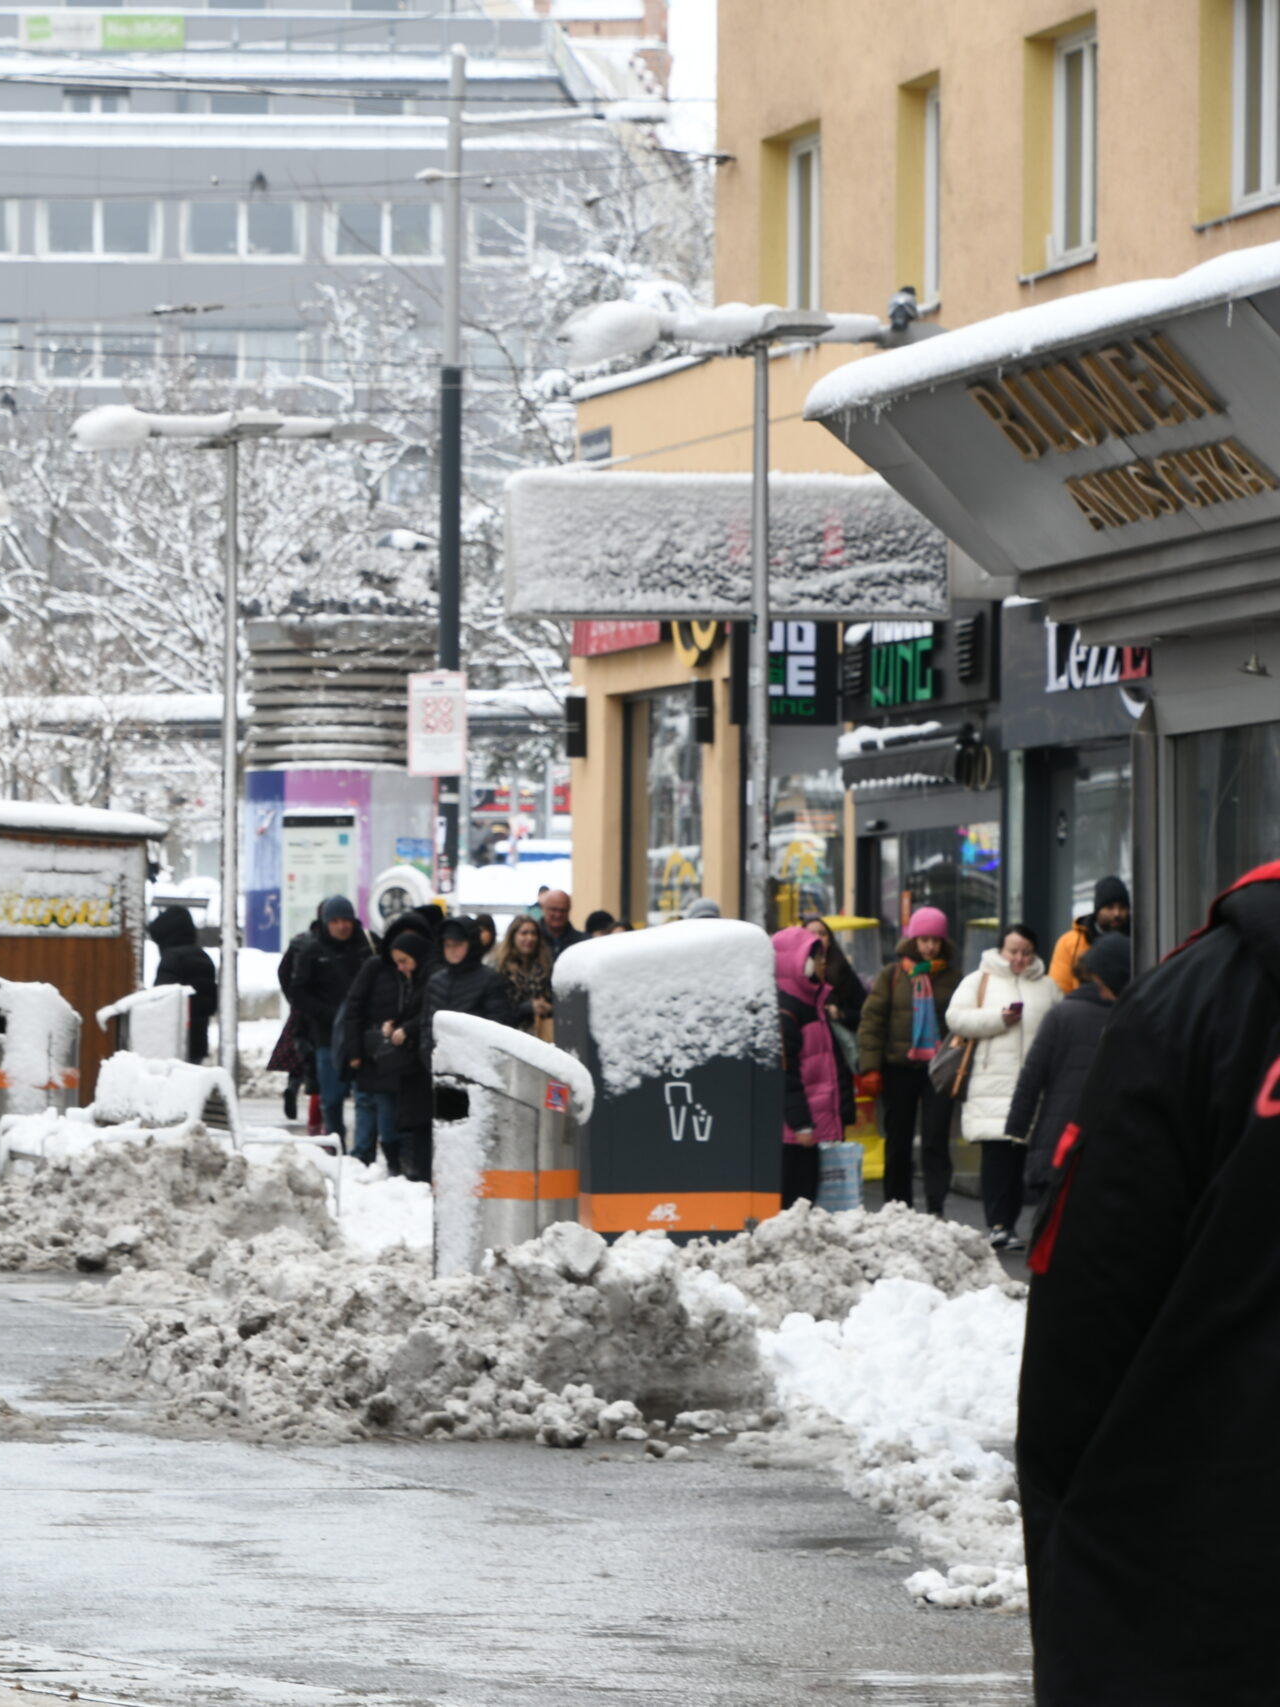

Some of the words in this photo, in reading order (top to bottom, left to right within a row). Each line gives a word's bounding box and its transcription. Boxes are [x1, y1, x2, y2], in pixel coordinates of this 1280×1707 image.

[968, 336, 1227, 463] BLUMEN
[1065, 437, 1280, 533] ANUSCHKA
[871, 636, 934, 709] KING
